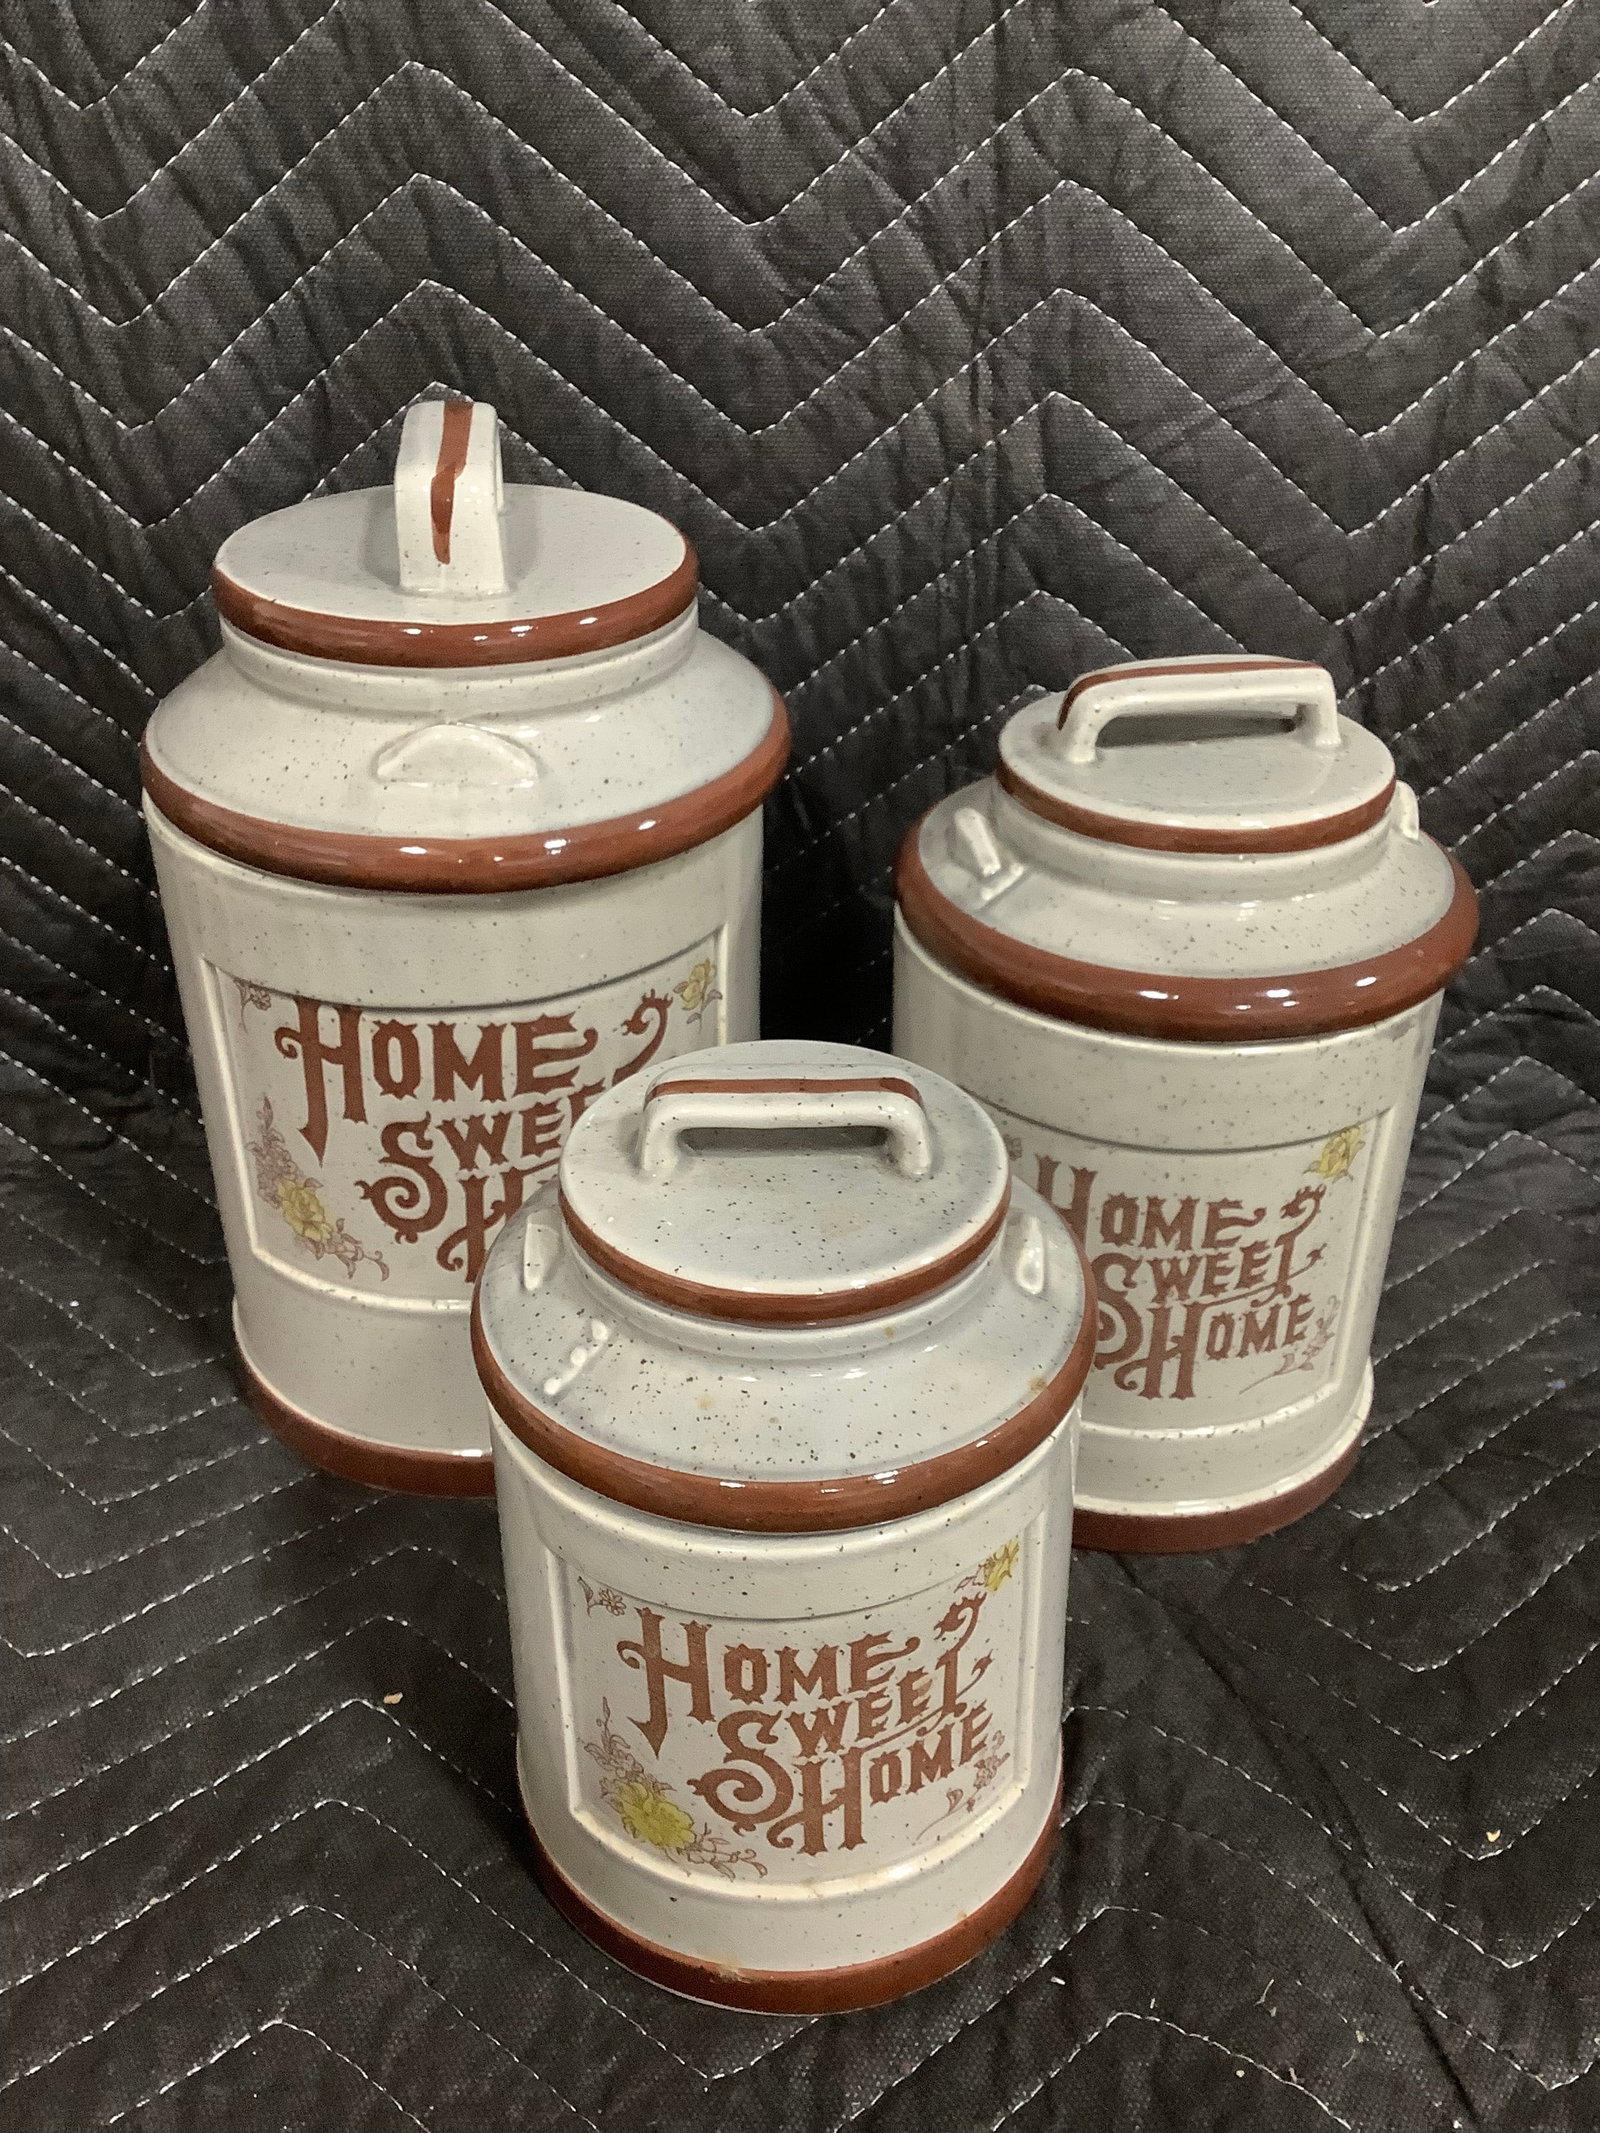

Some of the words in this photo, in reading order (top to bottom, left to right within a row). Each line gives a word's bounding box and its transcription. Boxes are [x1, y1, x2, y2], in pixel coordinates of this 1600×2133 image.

[273, 995, 599, 1168] HOME
[1091, 1183, 1327, 1369] SWEET
[1113, 1292, 1316, 1401] HOME
[616, 1606, 921, 1759] HOME
[687, 1592, 987, 1836] SWEET
[766, 1698, 994, 1857] HOME
